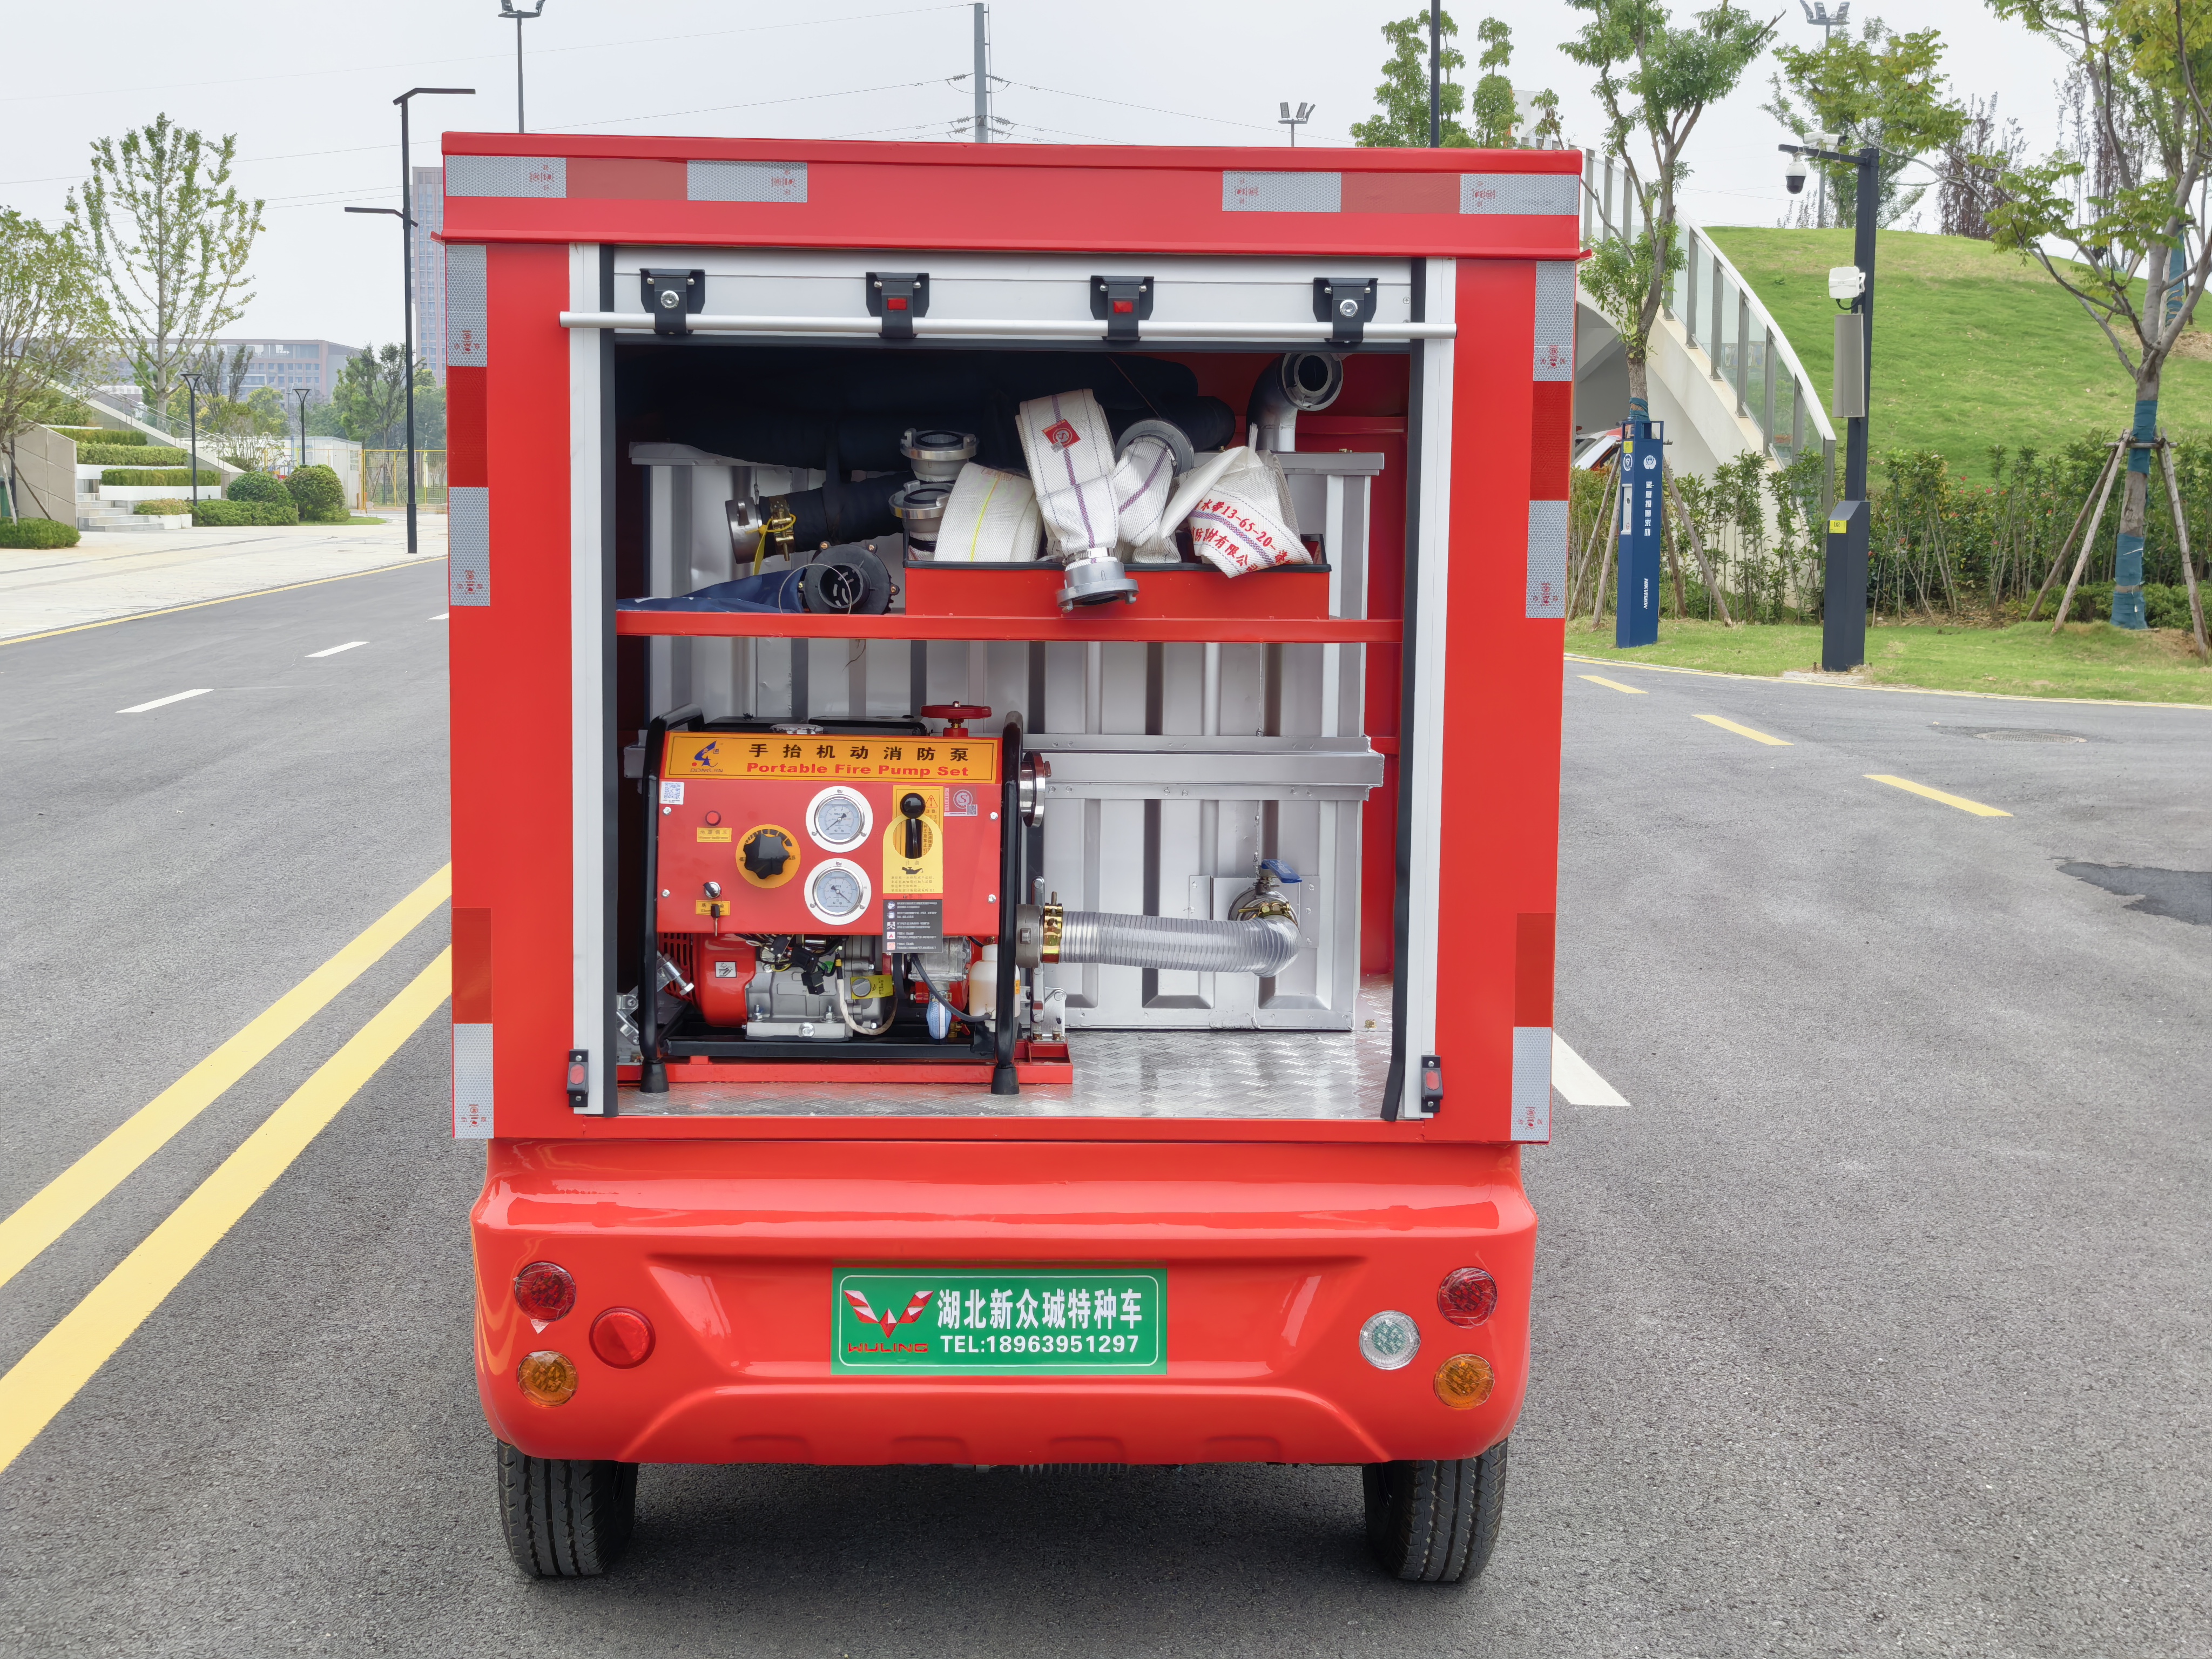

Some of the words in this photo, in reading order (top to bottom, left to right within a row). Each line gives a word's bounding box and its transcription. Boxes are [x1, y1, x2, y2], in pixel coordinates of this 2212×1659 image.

[749, 744, 969, 761] 手抬机动消防泵
[747, 763, 827, 773] Portable
[835, 764, 871, 774] Fire
[878, 765, 930, 778] Pump
[937, 766, 969, 776] Set
[848, 1343, 928, 1353] WULING
[940, 1335, 1138, 1352] TEL:18963951297
